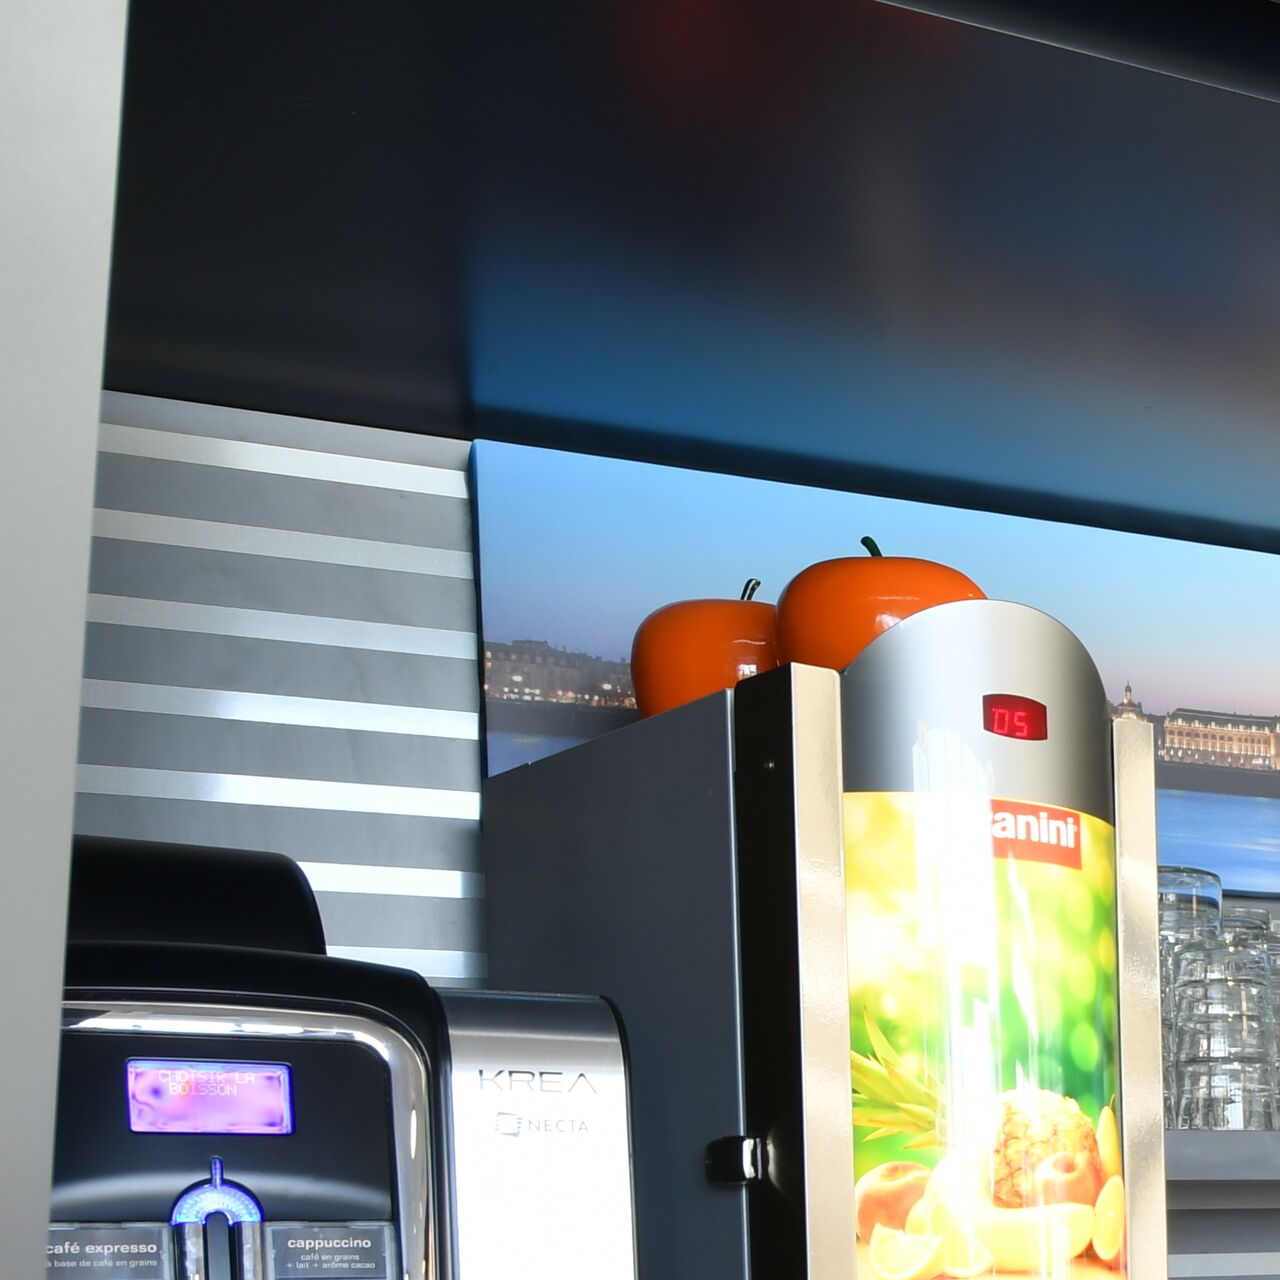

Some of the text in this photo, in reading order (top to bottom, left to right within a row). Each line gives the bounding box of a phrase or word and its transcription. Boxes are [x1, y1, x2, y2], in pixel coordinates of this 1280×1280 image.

[992, 708, 1028, 737] 05
[989, 812, 1076, 848] anini
[235, 1072, 255, 1084] LA
[169, 1083, 237, 1096] BOISSON
[528, 1119, 589, 1132] NECTA
[46, 1241, 157, 1256] café expresso
[287, 1237, 371, 1250] cappuccino
[54, 1259, 77, 1268] base
[79, 1259, 91, 1268] de
[93, 1259, 113, 1268] café
[115, 1259, 127, 1267] en
[129, 1258, 157, 1268] grains
[300, 1253, 319, 1261] café
[334, 1254, 360, 1262] grains
[350, 1261, 376, 1269] cacao
